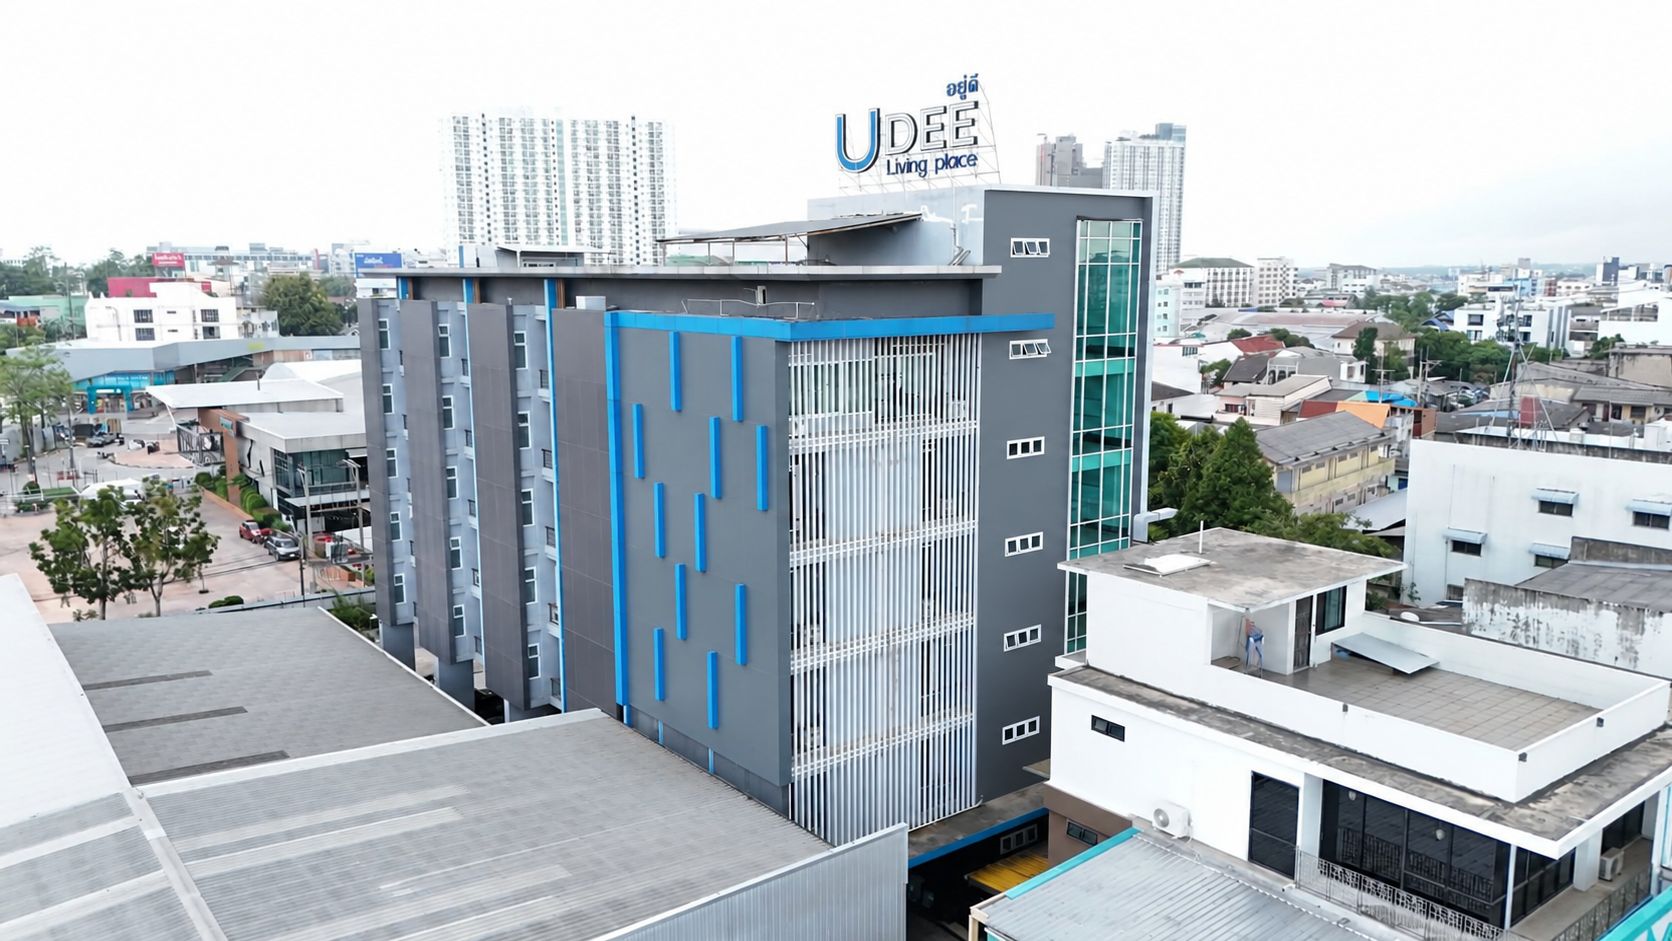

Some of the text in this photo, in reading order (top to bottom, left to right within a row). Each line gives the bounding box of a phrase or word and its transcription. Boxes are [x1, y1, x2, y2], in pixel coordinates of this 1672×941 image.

[946, 73, 979, 100] อยู่ดี
[835, 101, 979, 174] UDEE
[886, 153, 978, 178] Living place
